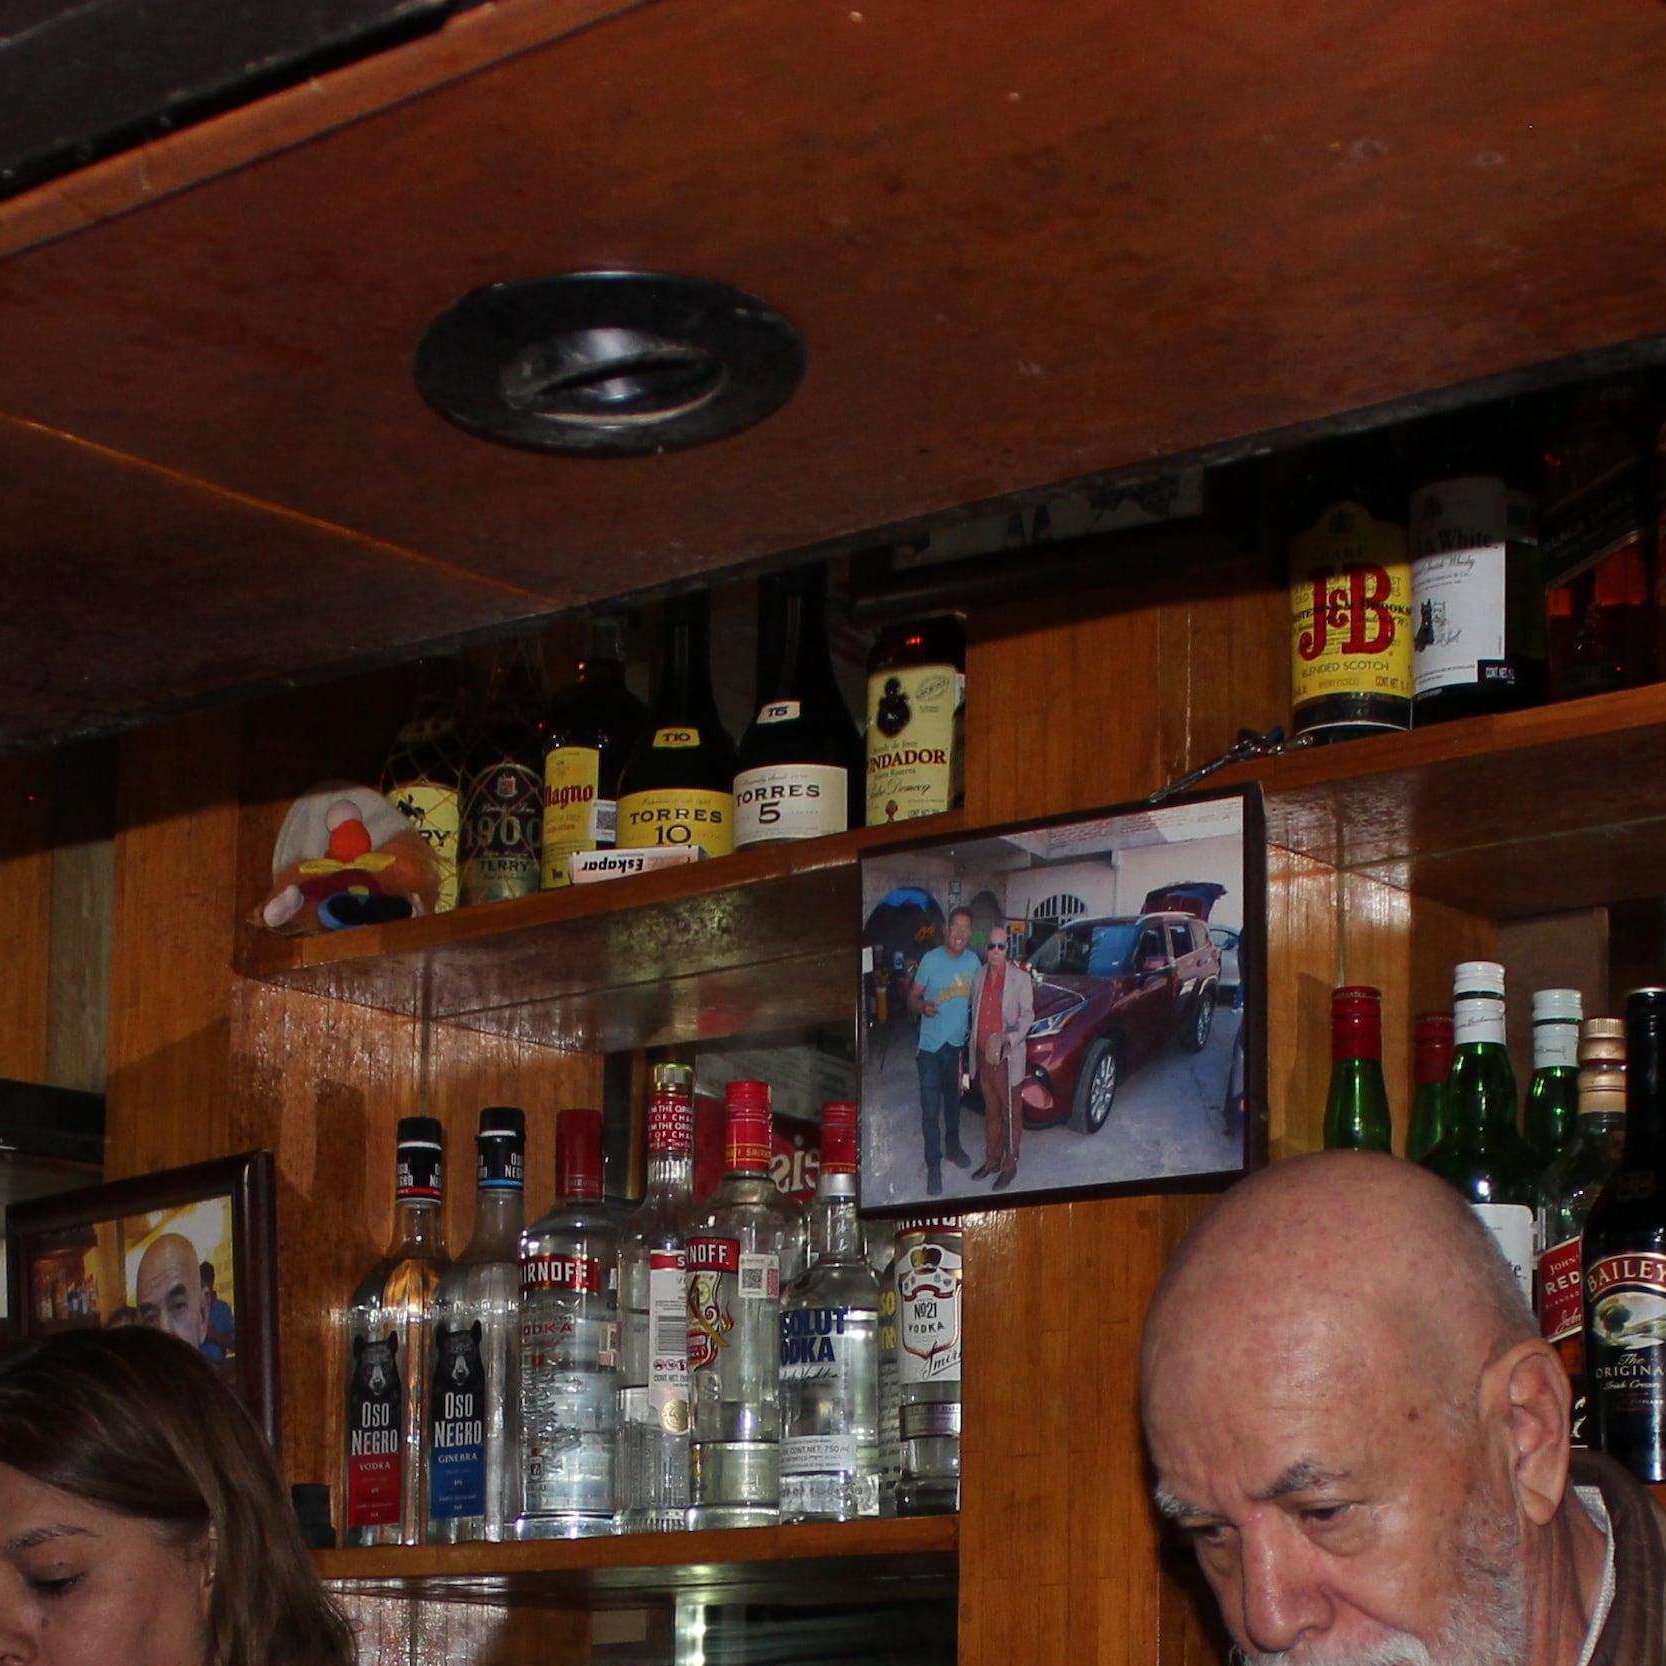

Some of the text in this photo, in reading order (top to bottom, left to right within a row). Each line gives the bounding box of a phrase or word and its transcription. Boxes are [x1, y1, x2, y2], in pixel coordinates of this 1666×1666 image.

[1299, 562, 1396, 661] J&B
[1343, 659, 1390, 673] SCOTCH
[736, 783, 821, 808] TORRES
[629, 807, 723, 825] TORRES
[758, 801, 782, 825] 5
[655, 825, 692, 845] 10
[581, 858, 644, 873] Eskapar
[1549, 1256, 1577, 1277] JOHN
[1544, 1272, 1582, 1296] RED
[522, 1321, 573, 1337] ODKA
[907, 1322, 946, 1335] VODKA
[1618, 1352, 1645, 1367] The
[361, 1401, 390, 1429] OSO
[444, 1391, 474, 1420] OSO
[351, 1428, 399, 1457] NEGRO
[434, 1419, 483, 1449] NEGRO
[358, 1461, 392, 1472] VODKA
[438, 1452, 478, 1464] GINEBRA
